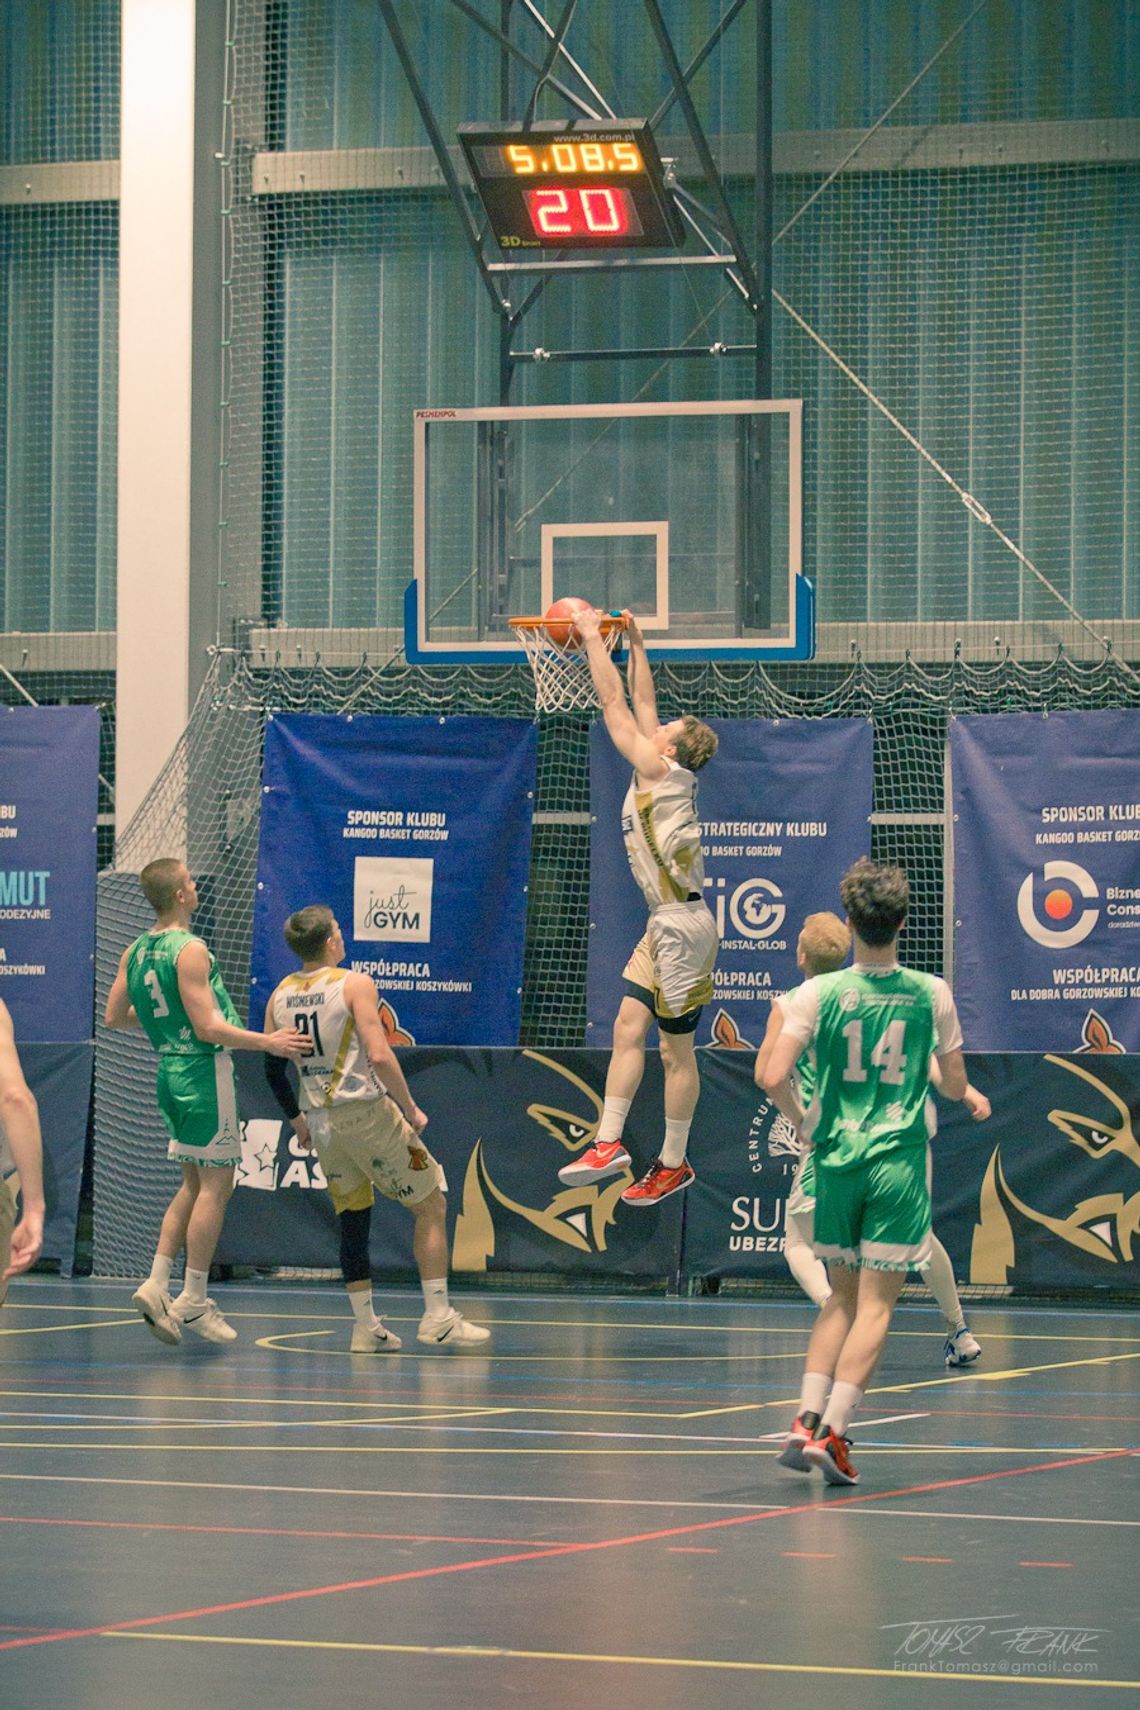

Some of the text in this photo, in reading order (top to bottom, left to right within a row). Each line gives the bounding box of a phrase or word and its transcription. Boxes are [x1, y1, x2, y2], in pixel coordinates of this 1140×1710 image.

[553, 132, 635, 142] www.3d.com.pl
[535, 189, 620, 232] 20
[500, 236, 521, 247] 3D
[347, 811, 446, 827] SPONSOR KLUBU
[1042, 806, 1105, 823] SPONSOR
[343, 828, 449, 841] KANGOO BASKET GORZÓW
[698, 822, 827, 837] STRATEGICZNY KLUBU
[1036, 830, 1140, 844] KANGOO BASKET GORZ
[712, 846, 744, 857] BASKET
[746, 844, 782, 857] GORZÓW
[364, 885, 417, 928] just
[373, 912, 420, 929] GYM
[719, 940, 787, 950] -INSTAL-GLOB
[351, 959, 430, 977] WSPÓŁPRACA
[144, 969, 170, 1018] 3
[375, 980, 472, 992] ZOWSKIEJ KOSZYKÓWKI
[1011, 990, 1027, 1000] DLA
[1029, 989, 1060, 1000] DOBRA
[1063, 987, 1128, 999] GORZOWSKIEJ
[713, 990, 754, 1000] ZOWSKIEJ
[842, 1019, 907, 1086] 14
[730, 1196, 788, 1232] SU
